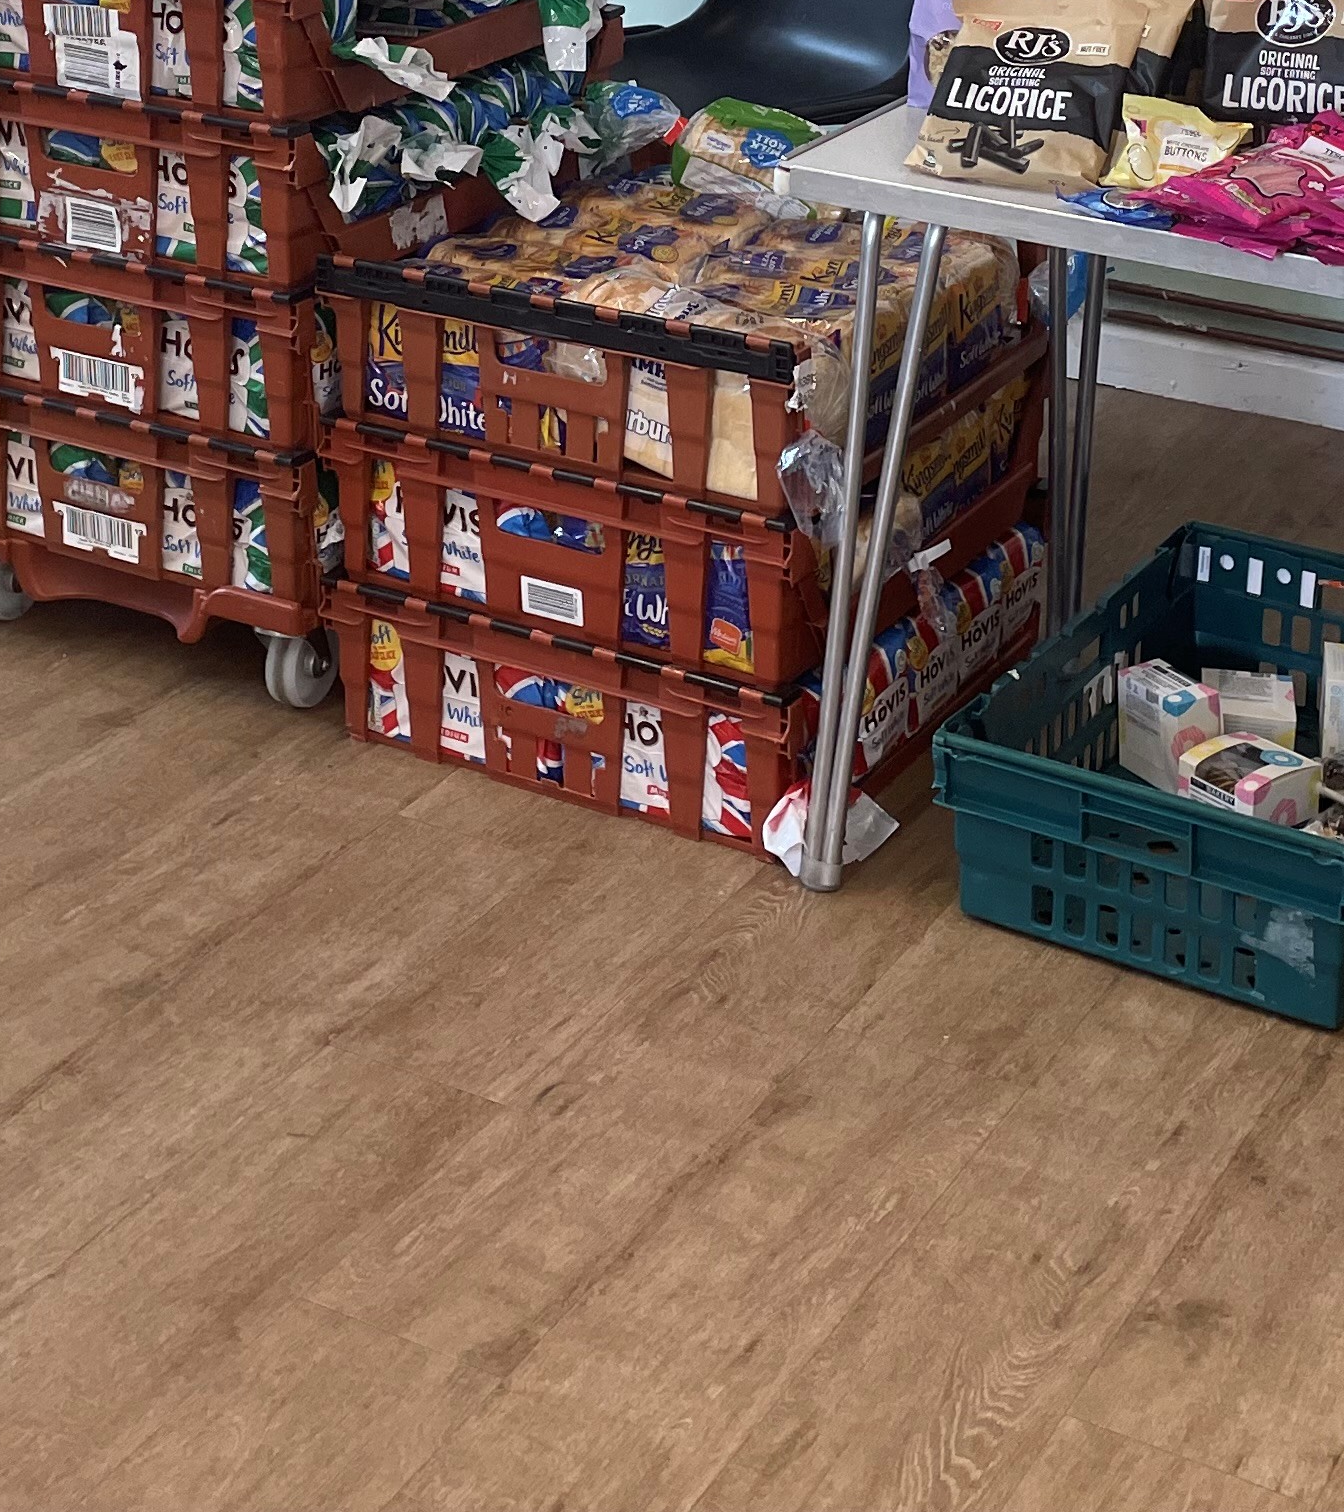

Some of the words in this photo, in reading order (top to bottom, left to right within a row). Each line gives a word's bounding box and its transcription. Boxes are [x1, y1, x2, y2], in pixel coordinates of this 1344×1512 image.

[1004, 30, 1062, 58] RJ's
[988, 65, 1046, 79] ORIGINAL
[1258, 49, 1321, 71] ORIGINAL
[988, 77, 1009, 87] SOFT
[1010, 77, 1041, 87] EATING
[1260, 66, 1282, 78] SOFT
[1284, 69, 1316, 80] EATING
[946, 77, 1073, 121] LICORICE
[1164, 145, 1208, 163] BUTTONS
[1005, 571, 1039, 609] HOVIS
[961, 606, 1000, 652] HOVIS
[864, 681, 907, 733] HOVIS
[624, 753, 655, 778] Soft
